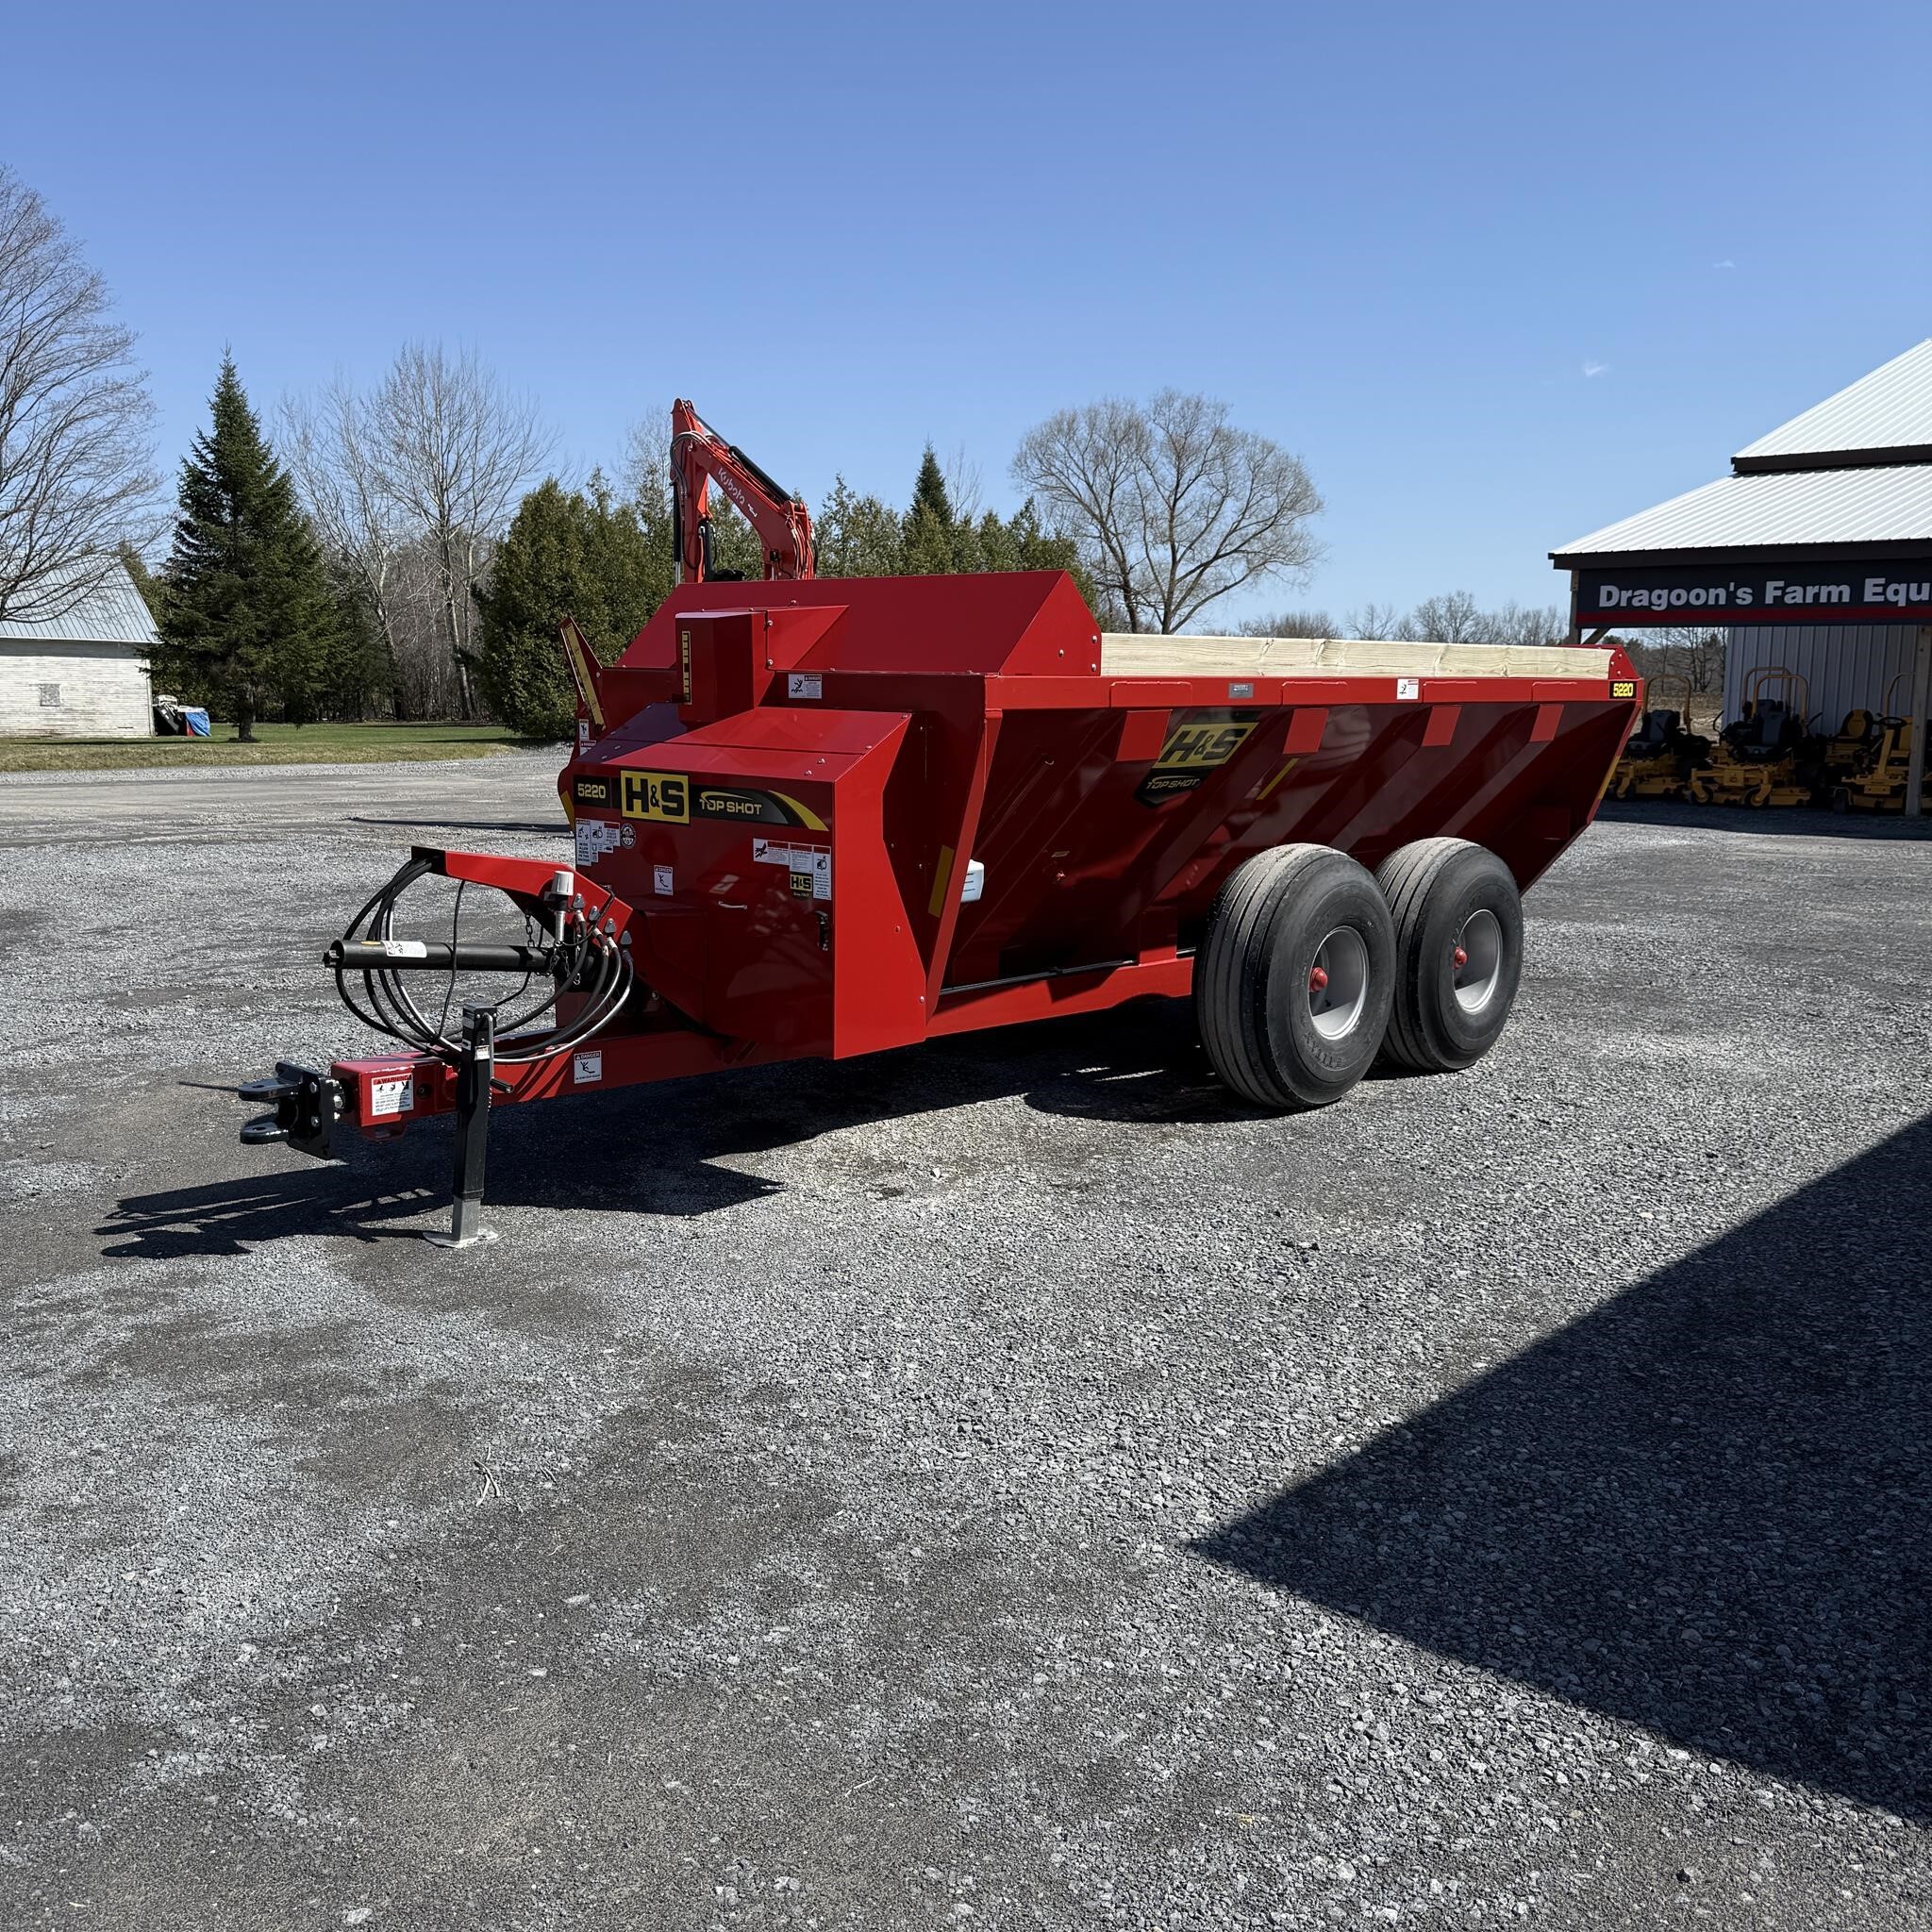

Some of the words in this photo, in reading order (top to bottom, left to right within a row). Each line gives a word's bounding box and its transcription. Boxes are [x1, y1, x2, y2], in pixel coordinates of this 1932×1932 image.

[718, 467, 745, 505] Kubota
[1598, 582, 1754, 611] Dragoon's
[1764, 580, 1851, 605] Farm
[1862, 577, 1932, 607] Equ
[1613, 682, 1633, 697] 5220
[1158, 727, 1248, 763] H&S
[577, 783, 607, 799] 5220
[625, 776, 685, 817] H&S
[699, 799, 724, 811] TOP
[726, 803, 763, 816] SHOT
[1146, 780, 1169, 790] TOP
[1169, 778, 1200, 789] SHOT
[381, 1074, 408, 1084] WARNING
